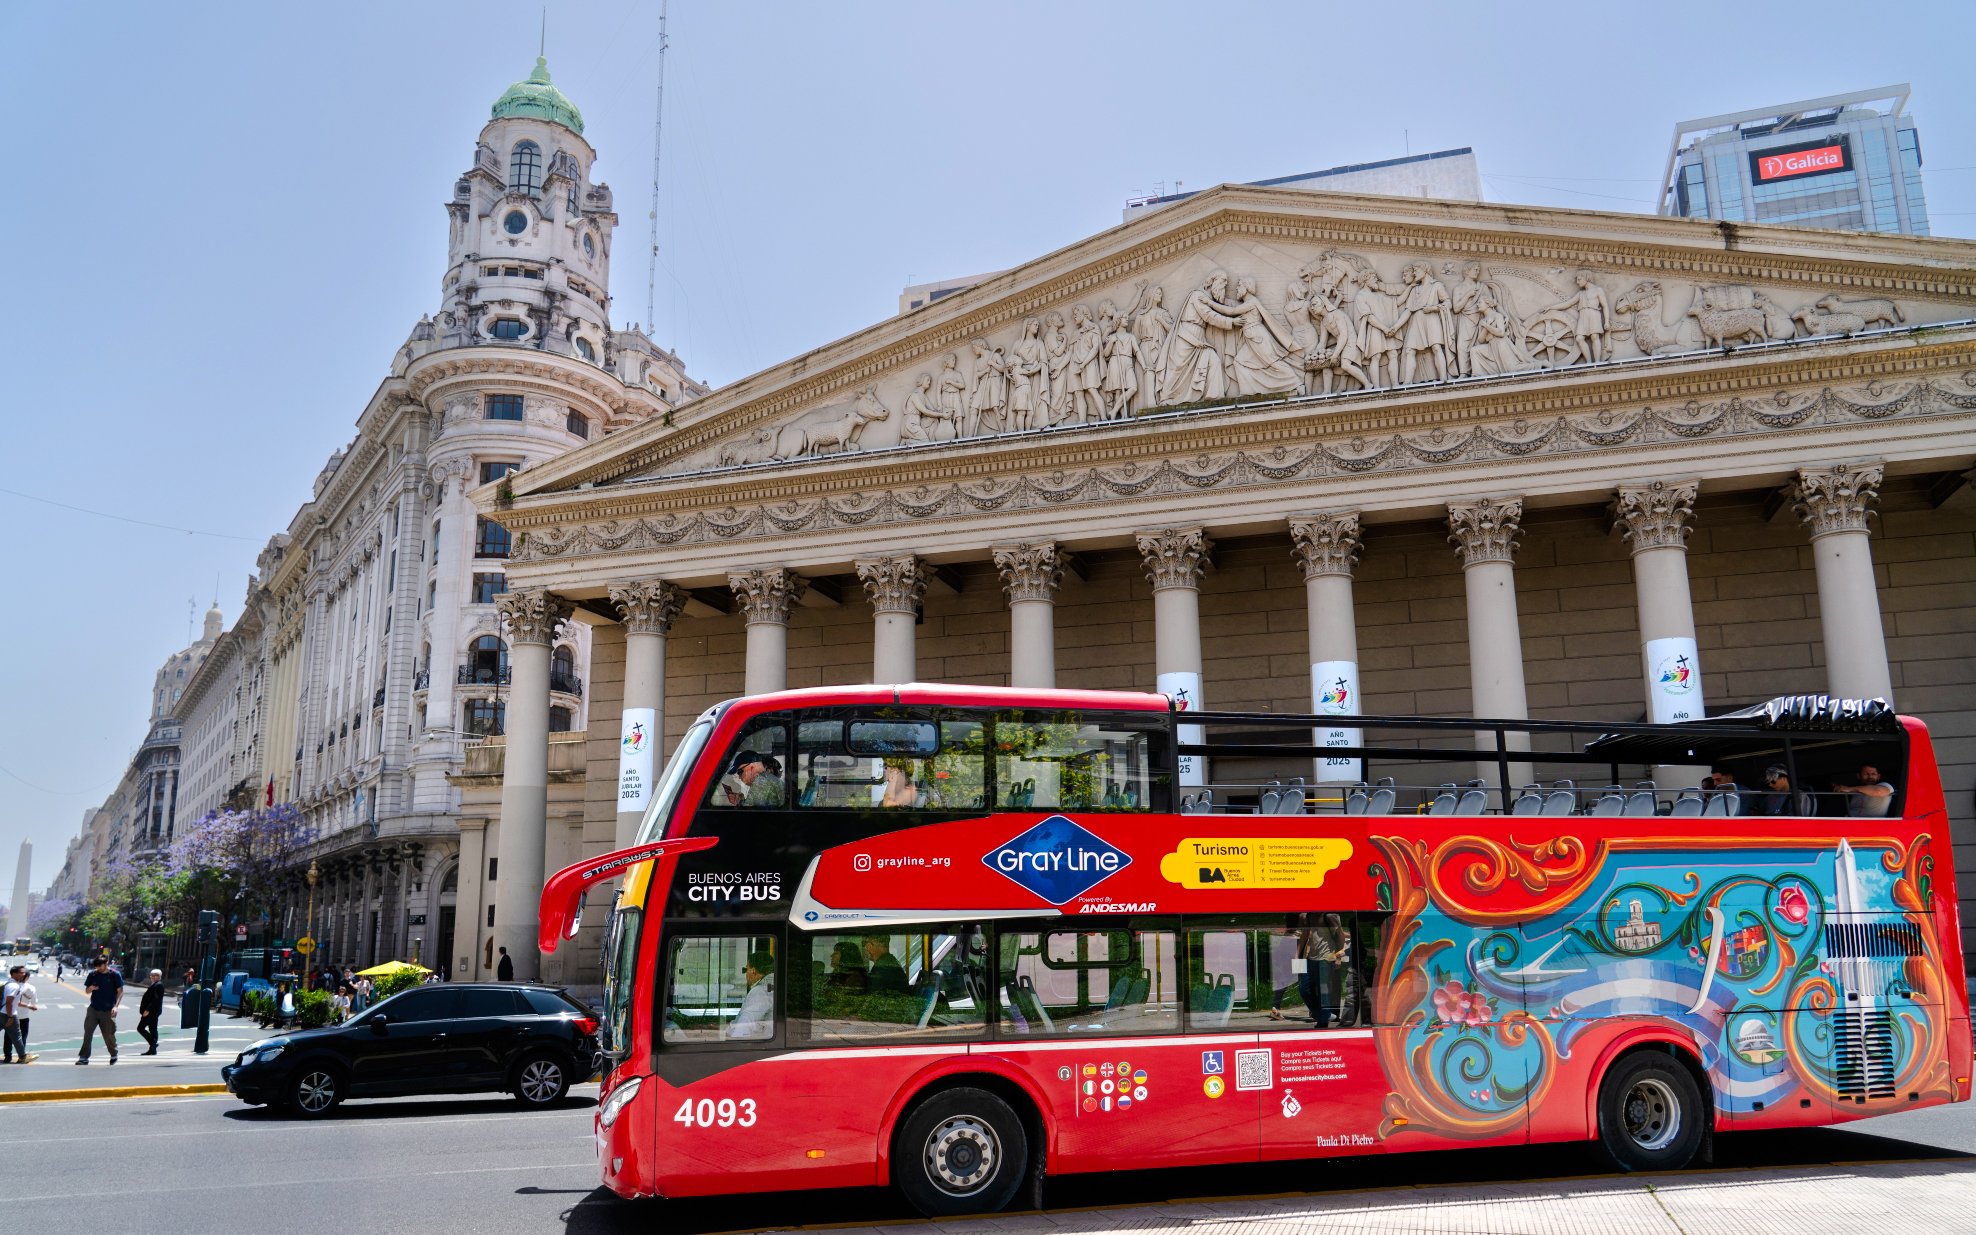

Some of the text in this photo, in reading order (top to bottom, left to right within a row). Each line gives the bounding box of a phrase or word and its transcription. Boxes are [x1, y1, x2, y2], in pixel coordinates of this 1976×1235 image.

[1786, 152, 1838, 170] Galicia
[1673, 711, 1689, 719] AÑO
[1326, 757, 1351, 766] 2025
[621, 790, 640, 799] 2025
[1192, 843, 1249, 856] Turismo
[877, 856, 951, 868] grayline_arg
[1067, 847, 1119, 872] Line
[688, 872, 781, 884] BUENOS AIRES
[1199, 867, 1226, 883] BA
[688, 885, 781, 901] CITY BUS
[1105, 896, 1113, 904] By
[1078, 902, 1157, 914] ANDESMAR
[1281, 1074, 1348, 1083] buenosairescitybus.com
[673, 1098, 757, 1128] 4093
[1317, 1133, 1374, 1147] Paula Di Pietro
